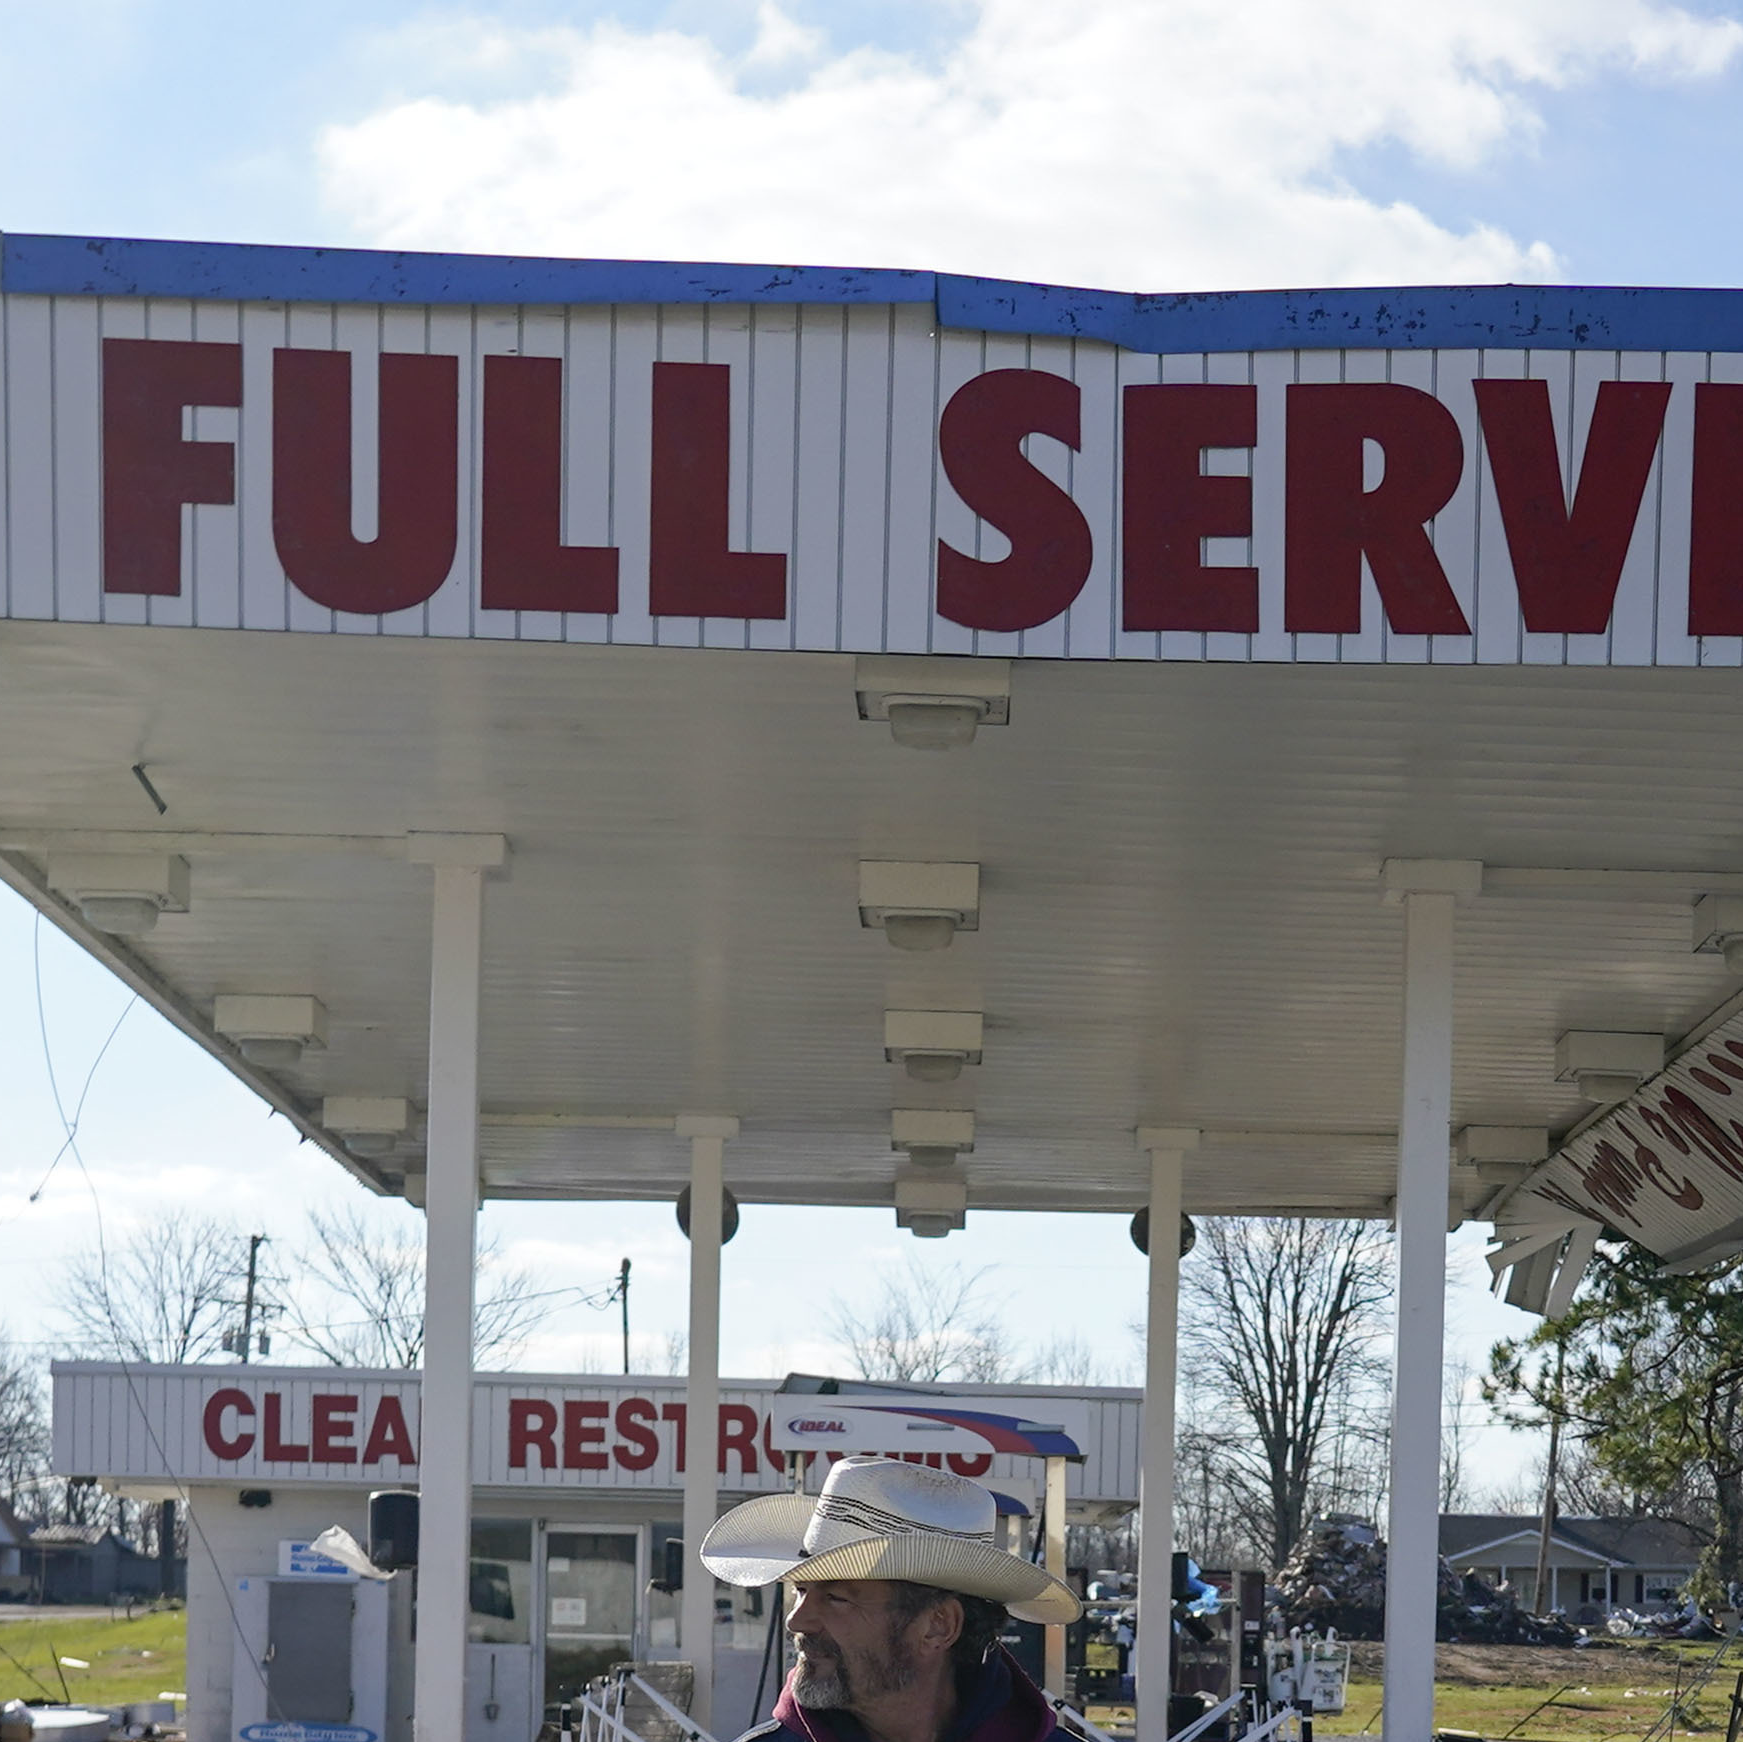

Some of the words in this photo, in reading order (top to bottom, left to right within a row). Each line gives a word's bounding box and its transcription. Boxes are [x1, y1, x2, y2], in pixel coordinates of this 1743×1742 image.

[102, 337, 788, 619] FULL
[203, 1387, 418, 1466] CLEA
[509, 1397, 993, 1478] RESTR
[798, 1420, 846, 1432] IDEAL
